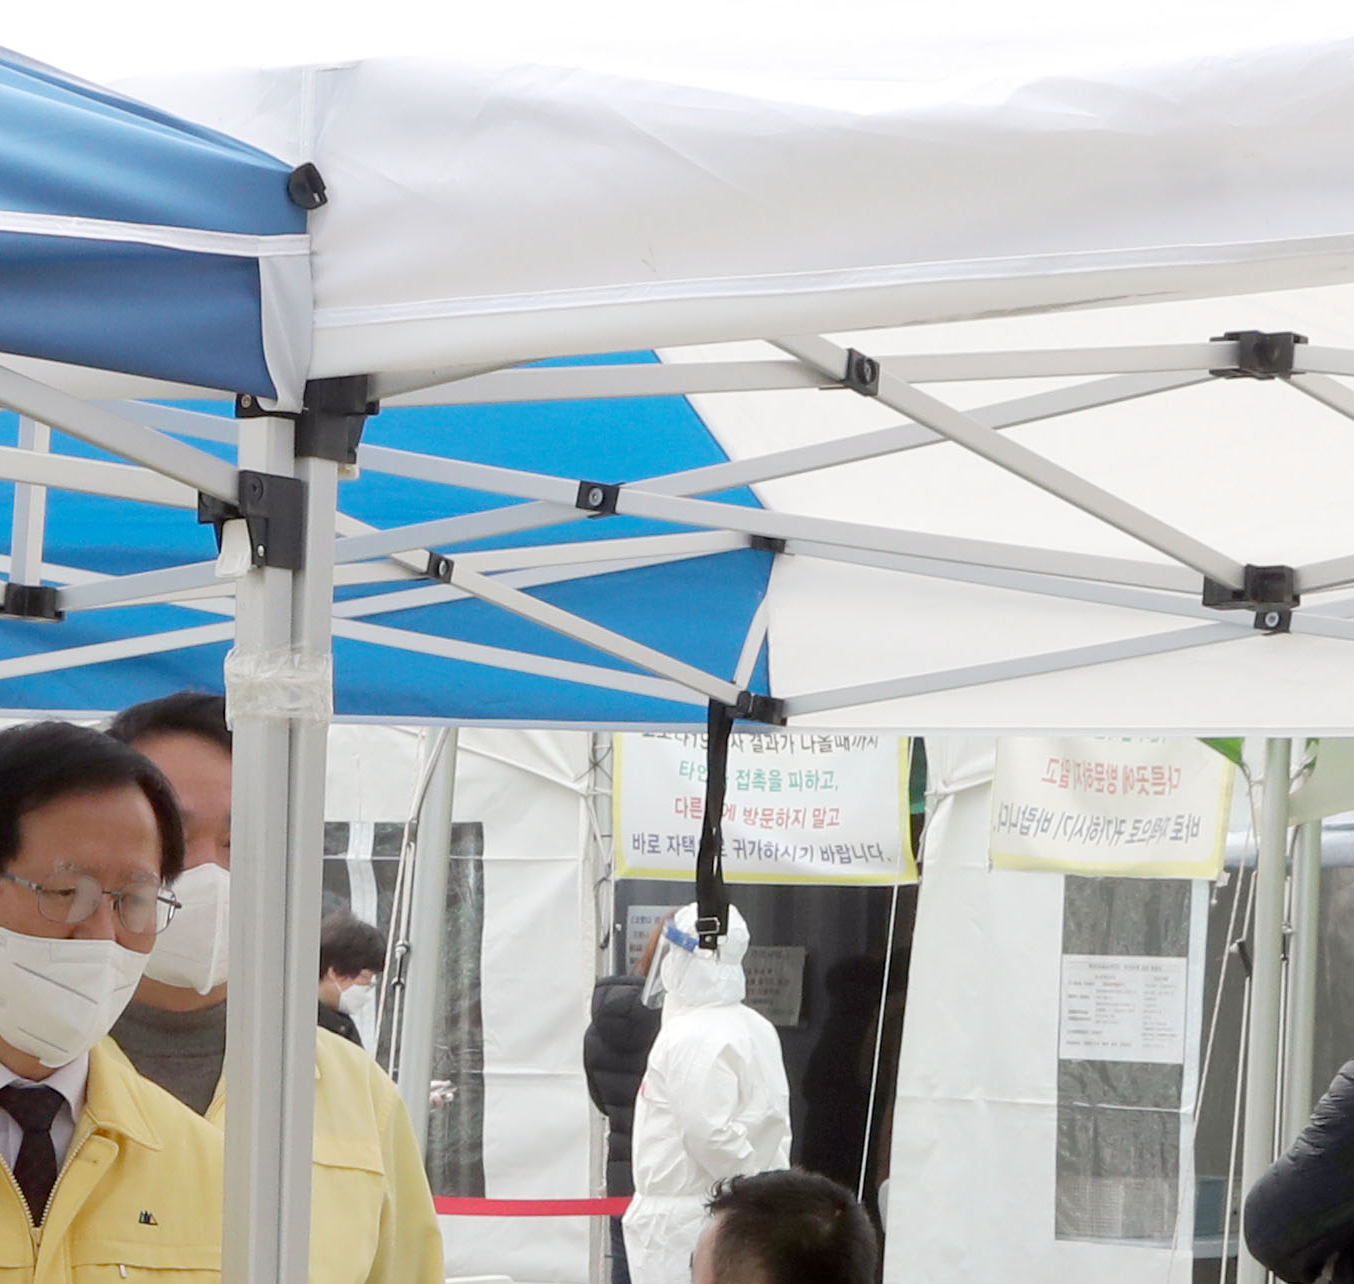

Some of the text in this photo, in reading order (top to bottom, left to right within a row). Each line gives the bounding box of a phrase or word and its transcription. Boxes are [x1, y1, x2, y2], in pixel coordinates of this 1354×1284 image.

[751, 734, 794, 754] 결과가
[736, 769, 782, 791] 접촉을
[788, 770, 838, 791] 피하고,
[743, 807, 806, 829] 방문하지
[812, 808, 840, 829] 말고
[632, 833, 661, 854] 바로
[733, 838, 814, 861] 귀가하시기
[820, 842, 891, 864] 바랍니다.
